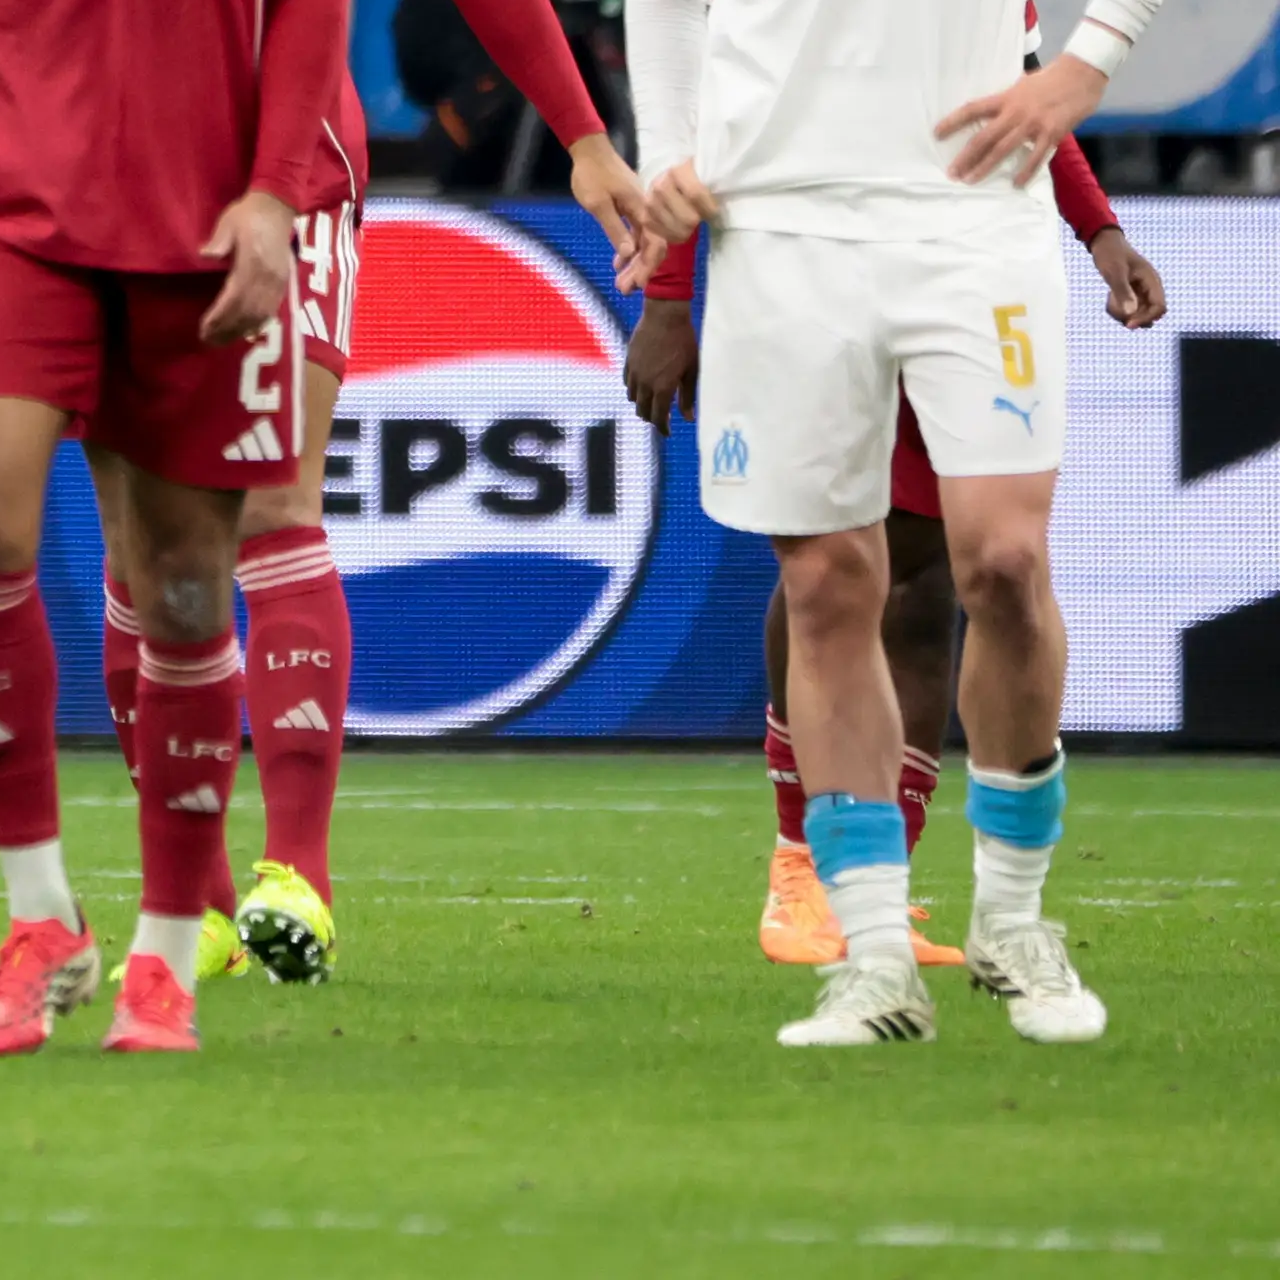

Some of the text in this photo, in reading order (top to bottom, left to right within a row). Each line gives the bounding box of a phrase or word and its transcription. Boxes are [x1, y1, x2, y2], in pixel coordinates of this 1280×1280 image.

[294, 210, 333, 297] 4
[239, 317, 283, 414] 2
[993, 304, 1036, 389] 5
[323, 417, 617, 517] EPSI
[266, 649, 332, 671] LFC
[167, 736, 233, 762] LFC
